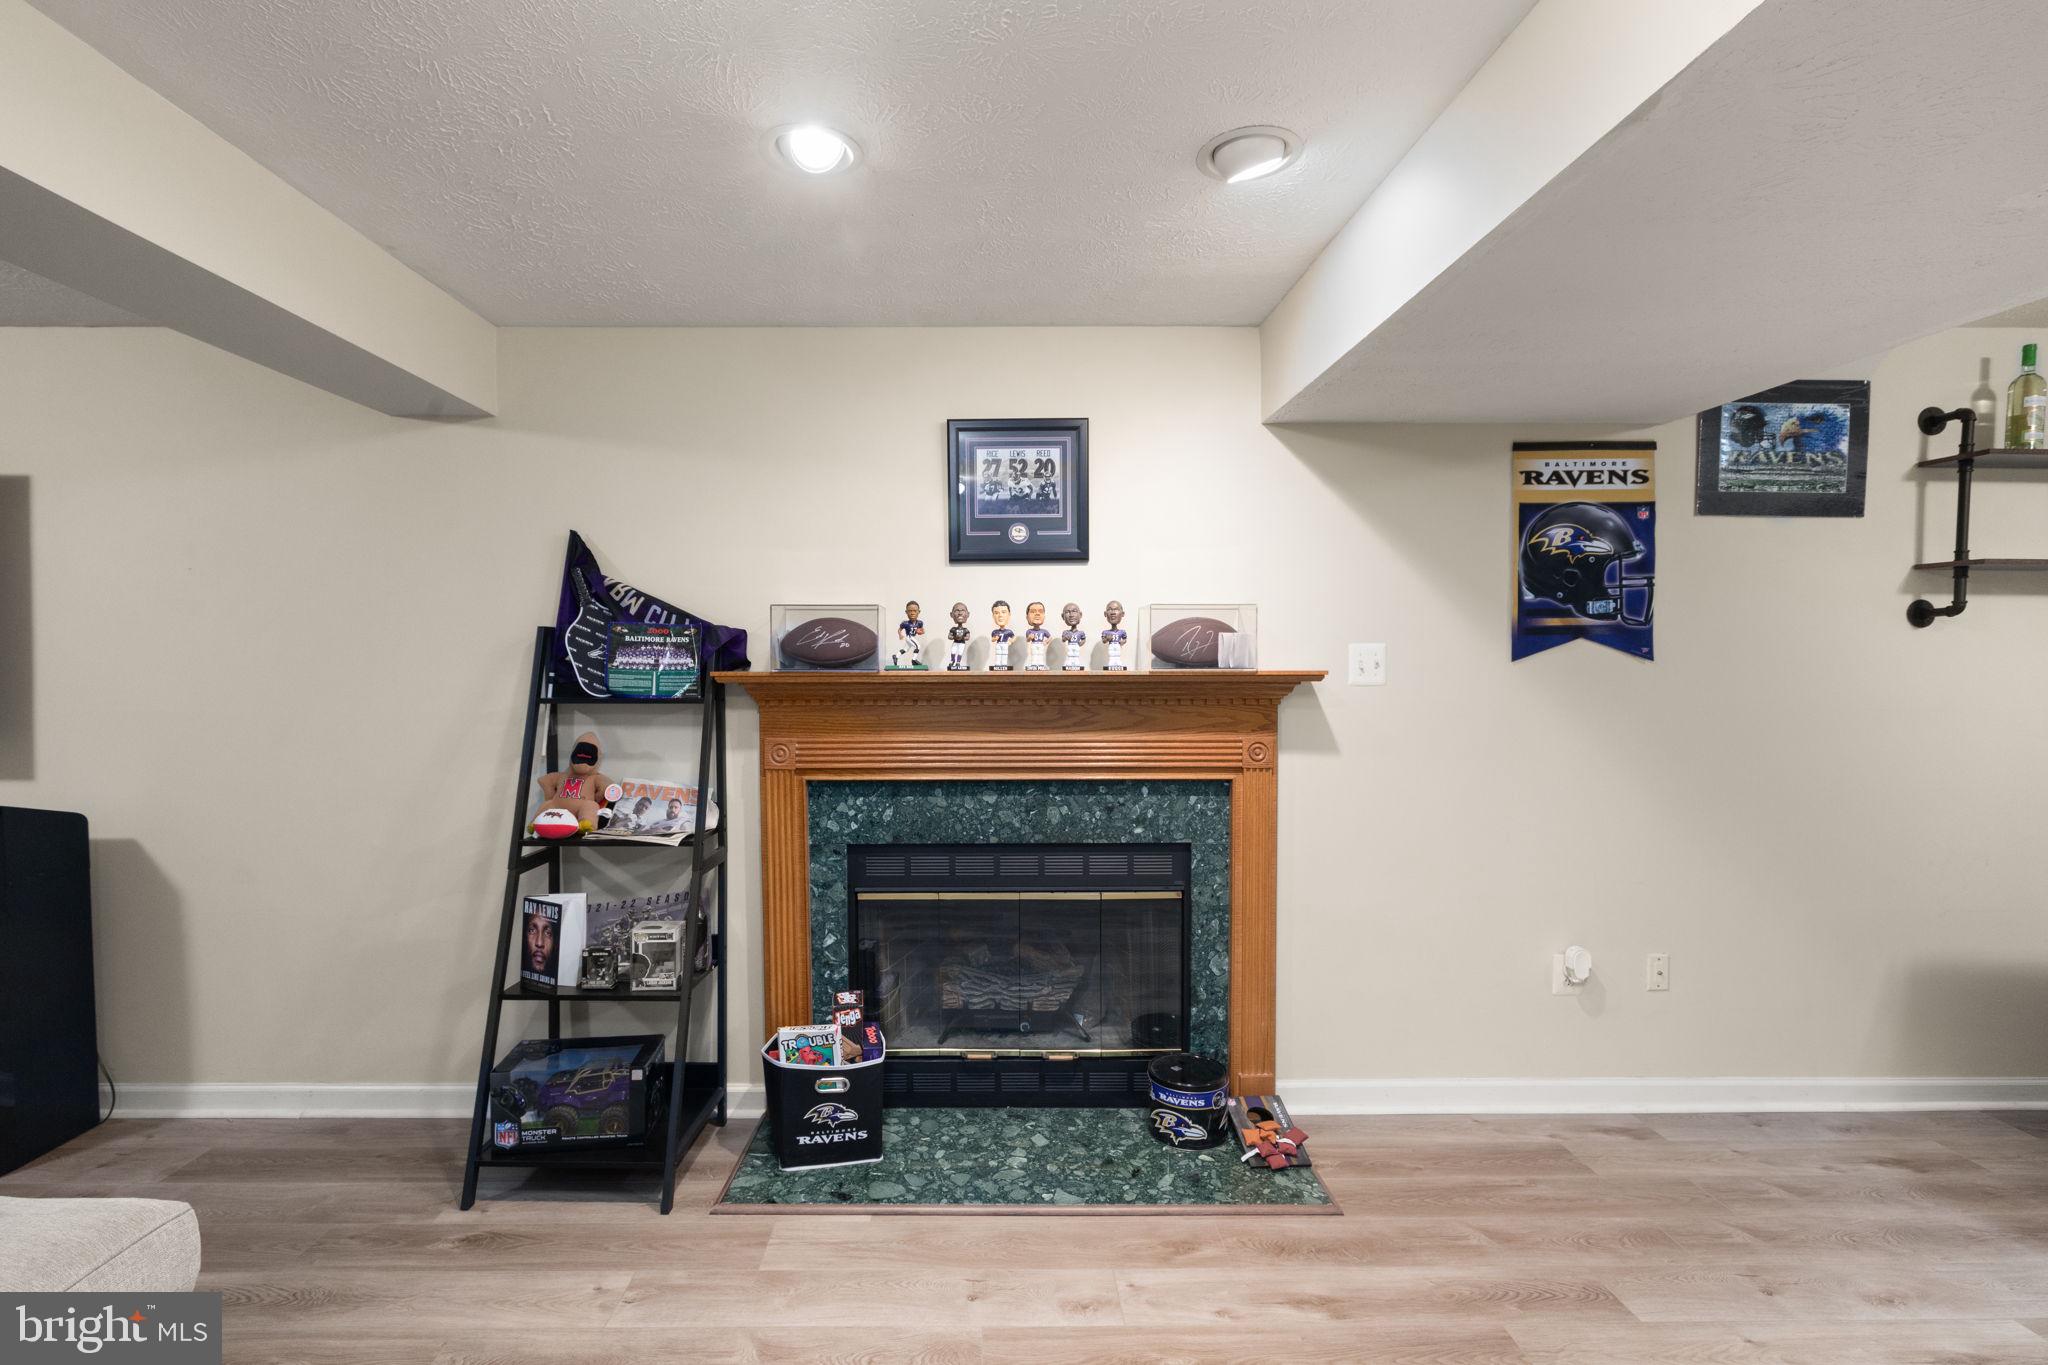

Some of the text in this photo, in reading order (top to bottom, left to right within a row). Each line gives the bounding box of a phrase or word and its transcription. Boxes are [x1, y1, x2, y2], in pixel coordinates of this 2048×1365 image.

[1036, 449, 1051, 457] REED
[982, 457, 1056, 478] 27 52 20
[1518, 469, 1650, 488] RAVENS
[625, 635, 664, 643] BALTIMORE
[560, 777, 585, 800] M
[646, 891, 690, 905] SEASO
[524, 900, 559, 919] RAY LEWIS
[834, 1008, 861, 1026] Jenga
[782, 1034, 835, 1051] TROUBLE
[1158, 1092, 1206, 1107] RAVENS
[497, 1131, 519, 1144] NFL
[521, 1128, 557, 1136] MONSTER
[796, 1130, 868, 1145] RAVENS
